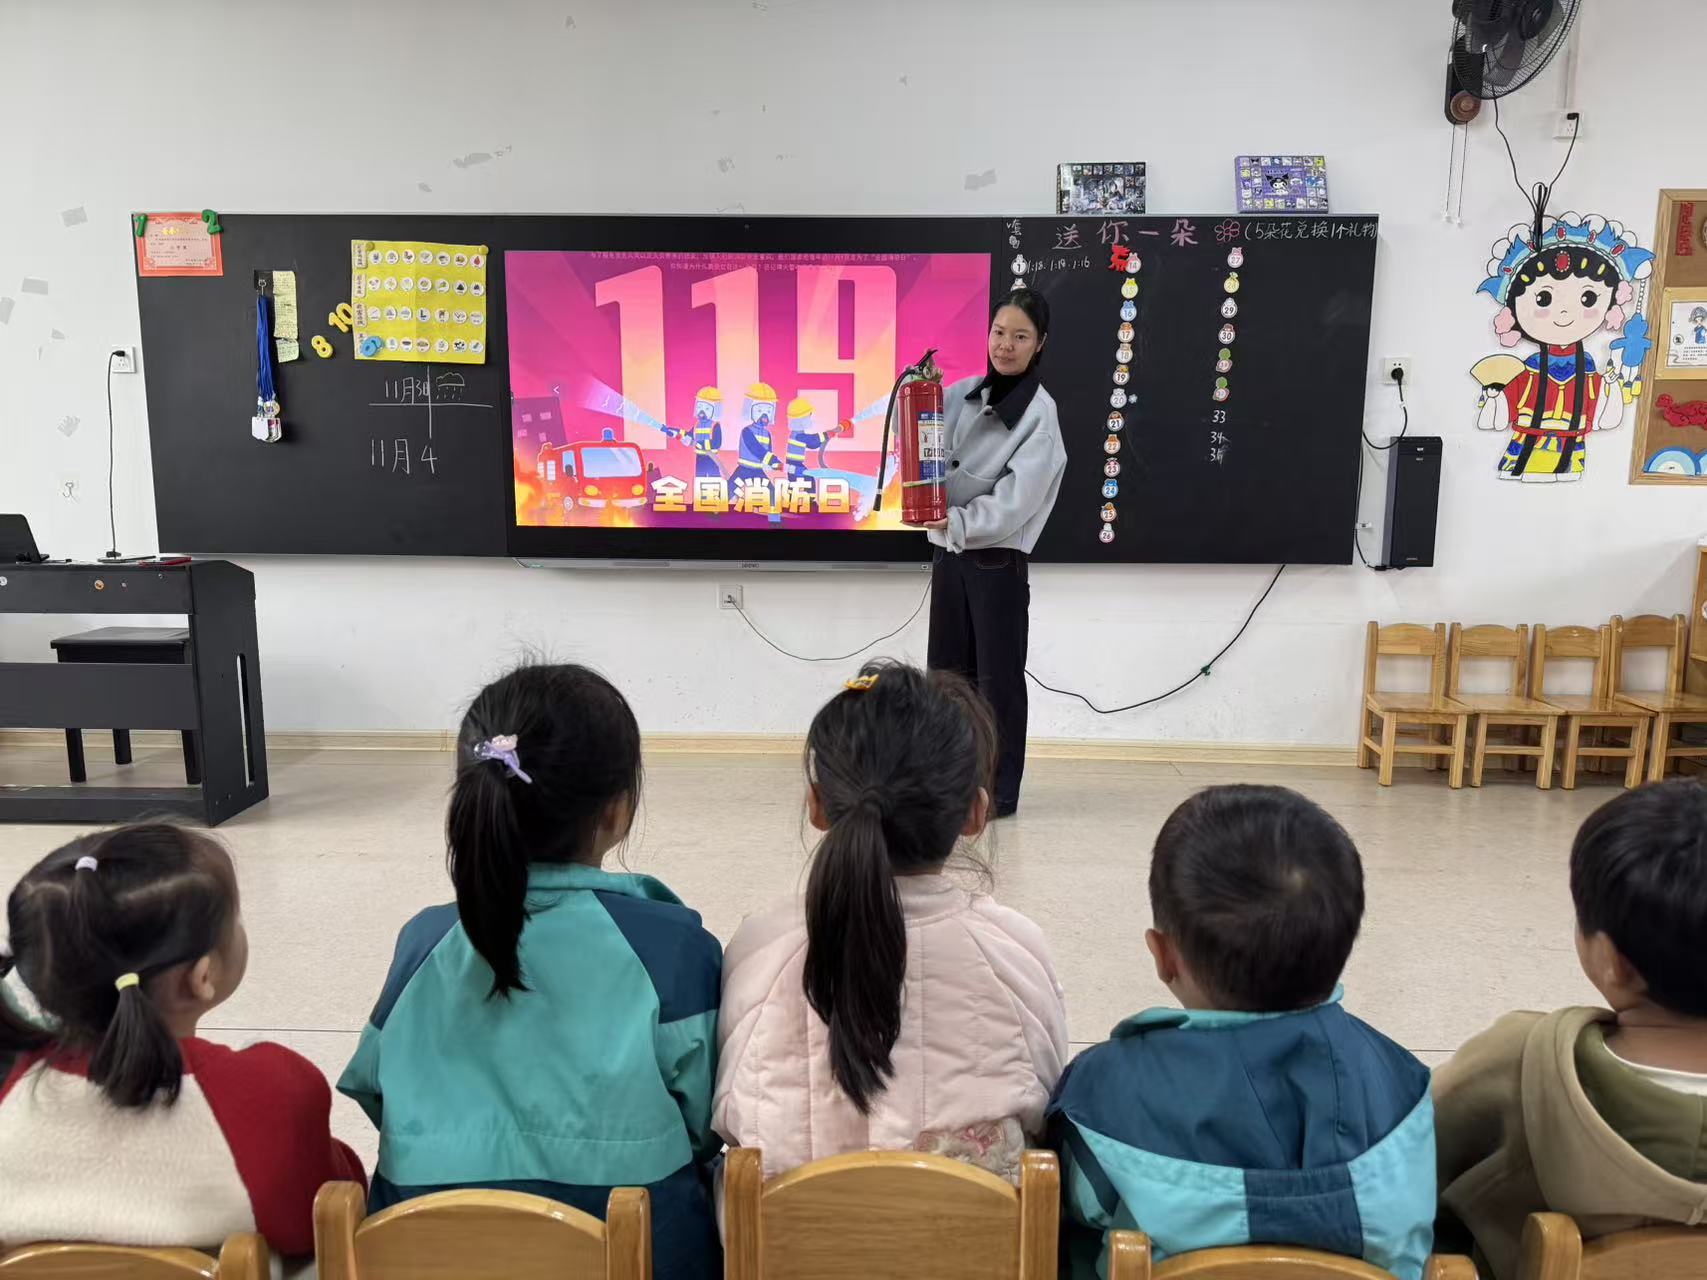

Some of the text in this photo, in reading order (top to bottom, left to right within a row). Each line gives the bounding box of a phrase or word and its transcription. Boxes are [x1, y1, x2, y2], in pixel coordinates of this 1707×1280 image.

[134, 213, 148, 237] 1
[201, 209, 223, 235] 2
[1052, 218, 1199, 250] 送你一朵
[311, 334, 334, 359] 8
[594, 264, 898, 452] 119
[1211, 409, 1226, 424] 33
[371, 438, 438, 475] 11月4
[650, 475, 850, 514] 全国消防日
